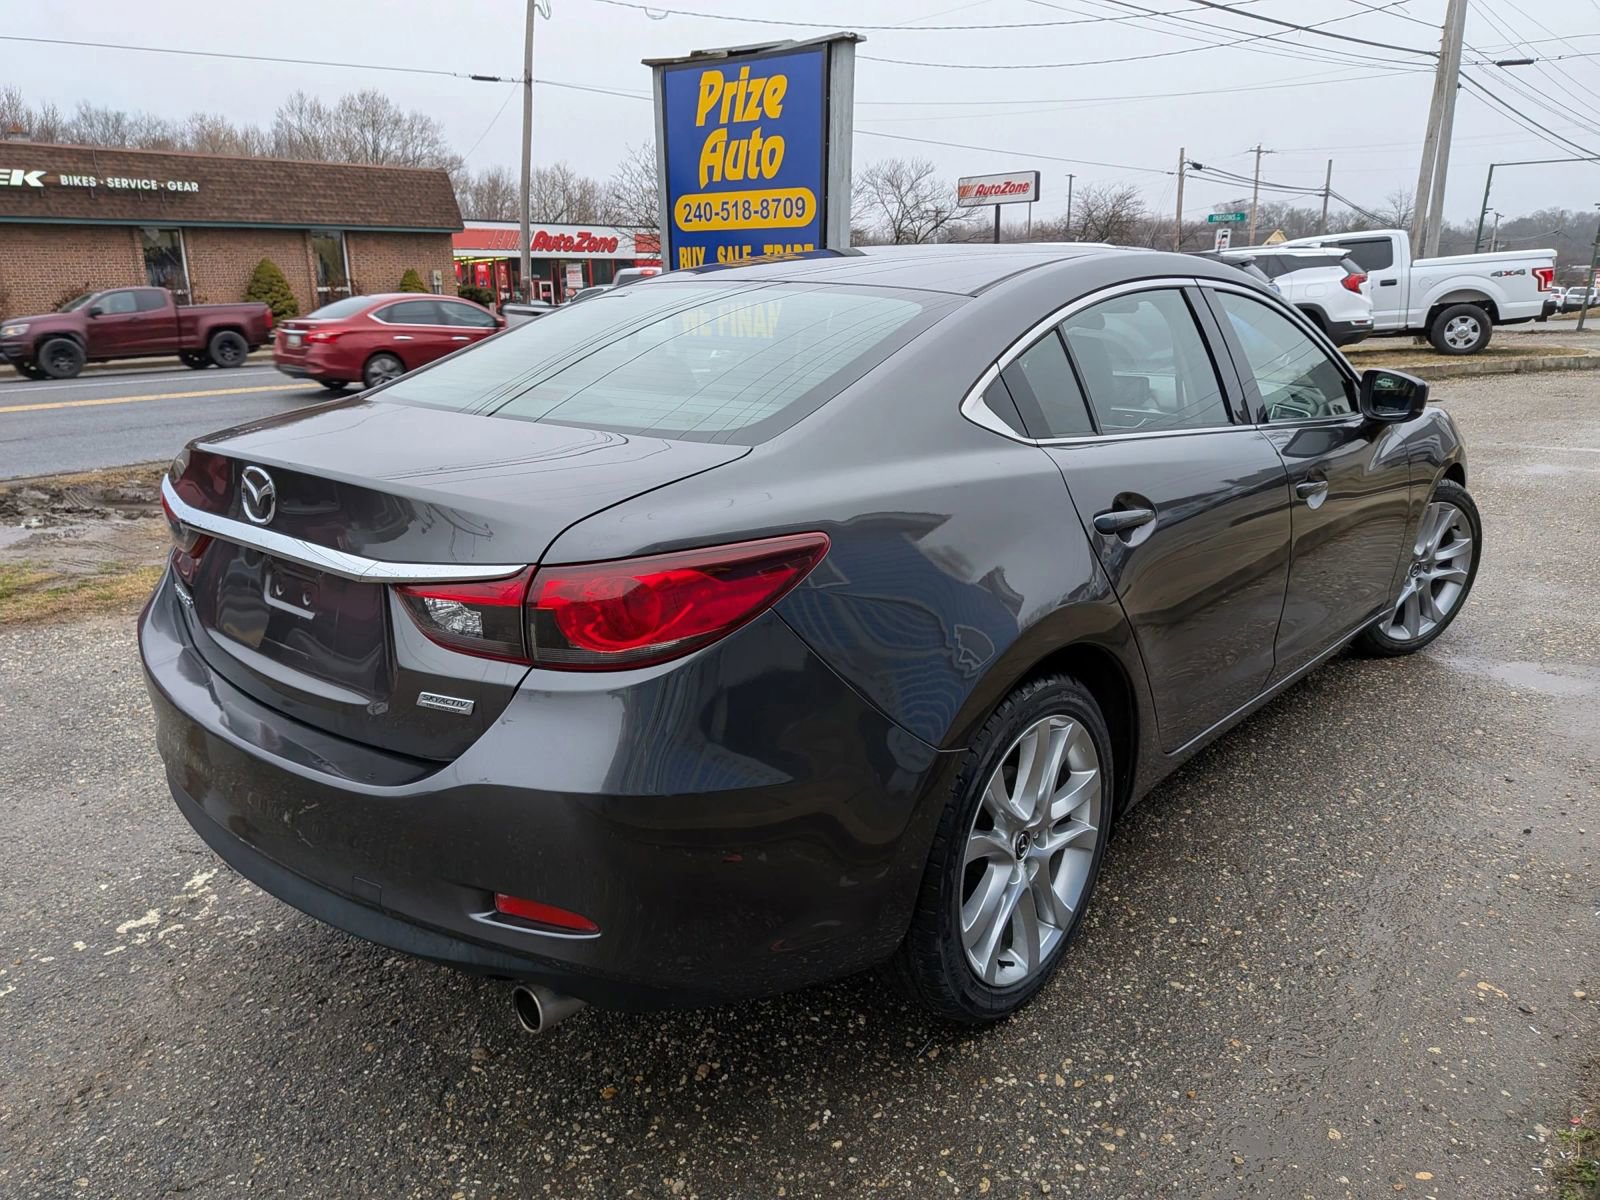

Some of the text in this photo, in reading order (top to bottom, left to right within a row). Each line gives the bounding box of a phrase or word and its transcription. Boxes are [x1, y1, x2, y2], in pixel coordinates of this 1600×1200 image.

[695, 65, 789, 127] Prize
[699, 126, 786, 189] Auto
[59, 175, 97, 187] BIKES
[106, 177, 158, 190] SERVICE
[167, 181, 200, 192] GEAR
[974, 181, 1030, 198] AutoZone
[683, 197, 806, 223] 240-518-8709
[531, 230, 619, 253] AutoZone
[679, 246, 706, 270] BUY
[717, 245, 752, 264] SALE
[421, 695, 470, 708] SKYACTIV
